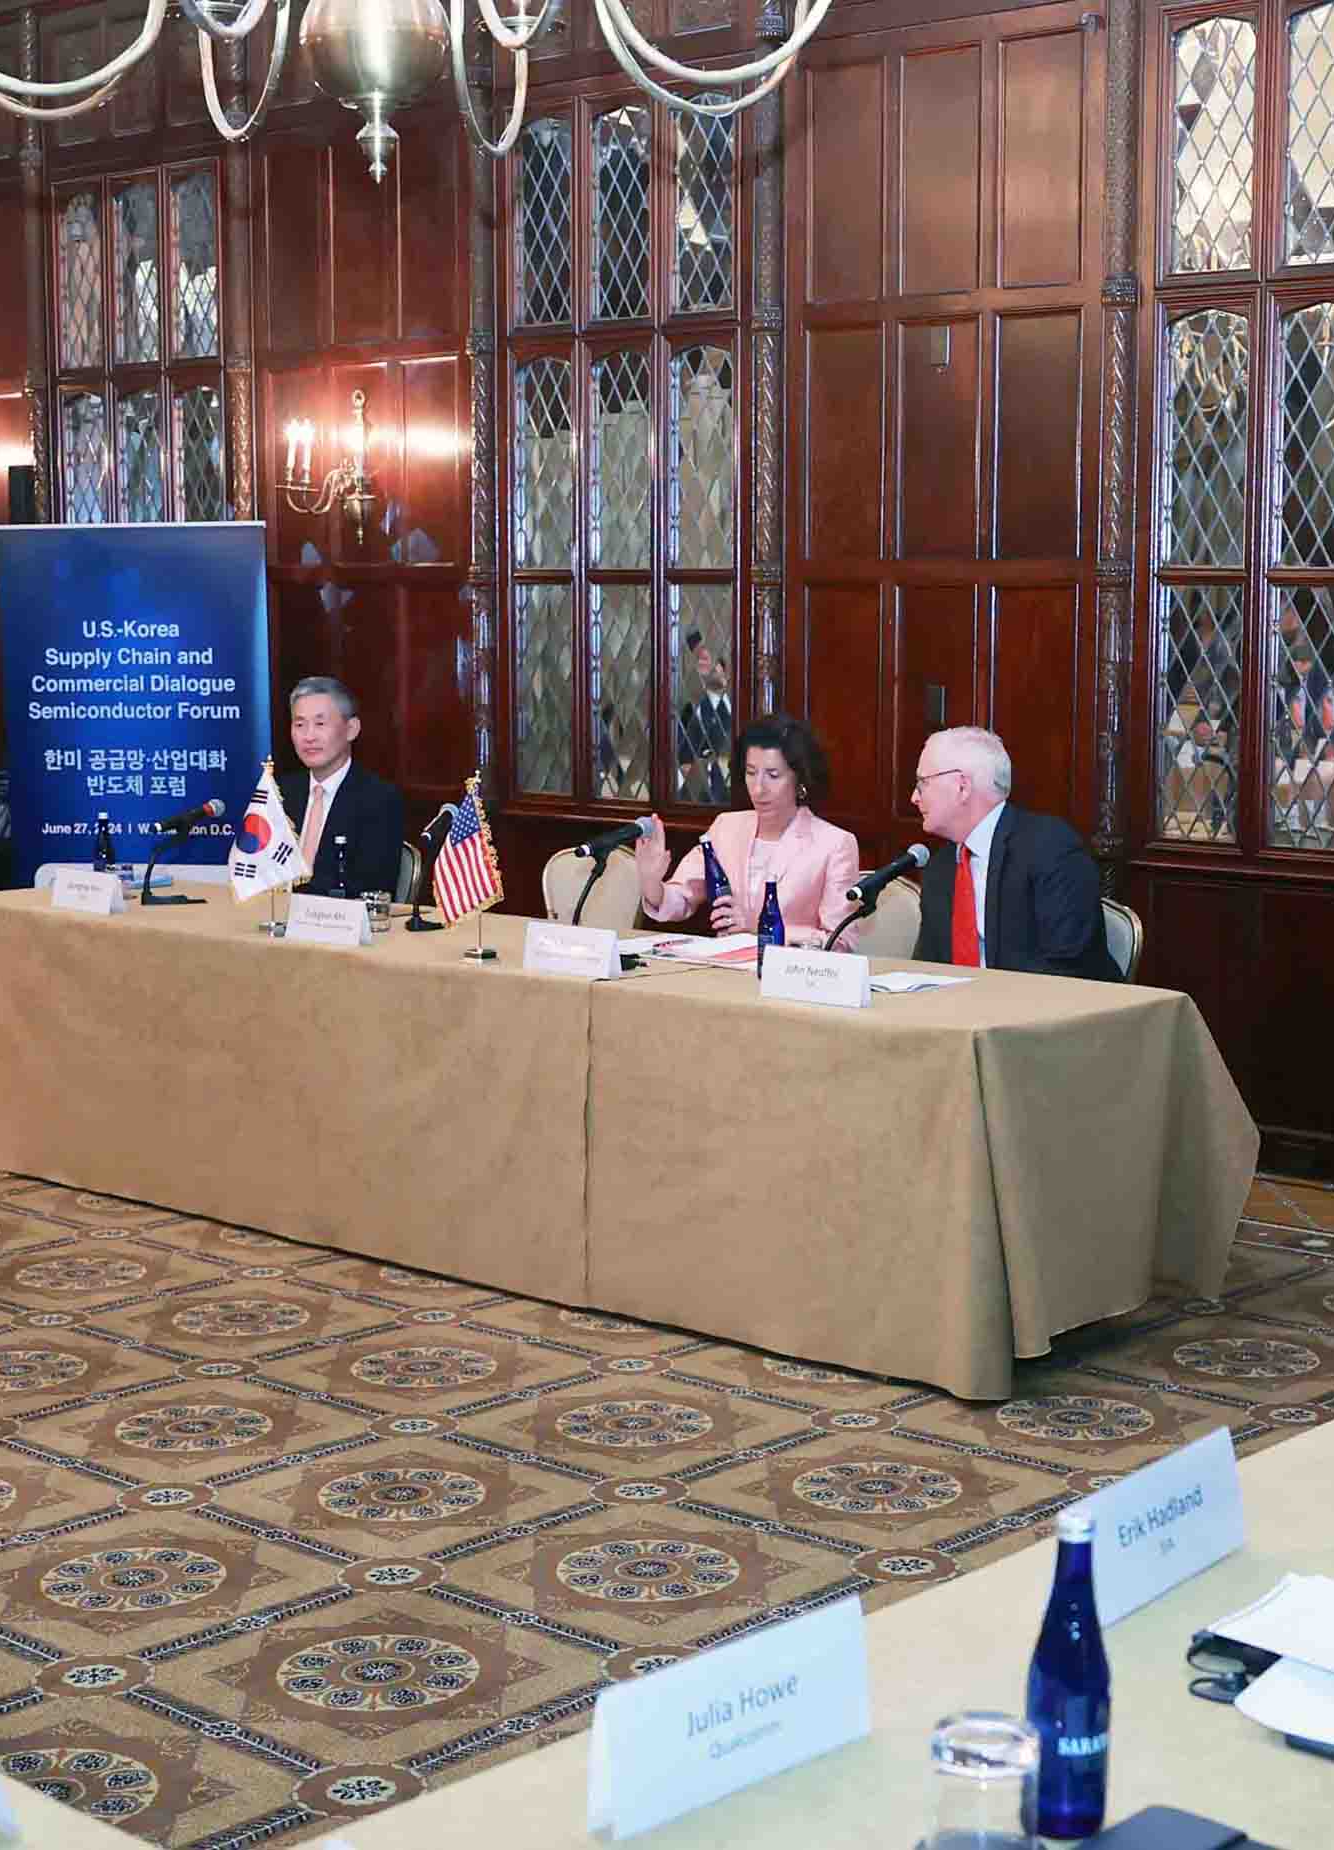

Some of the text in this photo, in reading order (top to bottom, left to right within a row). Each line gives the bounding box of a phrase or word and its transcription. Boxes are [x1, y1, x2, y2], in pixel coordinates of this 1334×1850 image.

[83, 621, 180, 639] U.S.-Korea
[45, 648, 213, 669] Supply Chain and
[32, 675, 236, 696] Commercial Dialogue
[28, 702, 241, 720] Semiconductor Forum
[44, 749, 228, 772] 한미 공급망·산업대화
[87, 775, 187, 797] 반도체 포럼
[42, 822, 72, 835] June
[73, 823, 92, 836] 27,
[94, 823, 123, 835] 224
[209, 823, 236, 836] D.C.
[1118, 1483, 1204, 1548] Erik Hadland
[686, 1672, 799, 1740] Julia Howe
